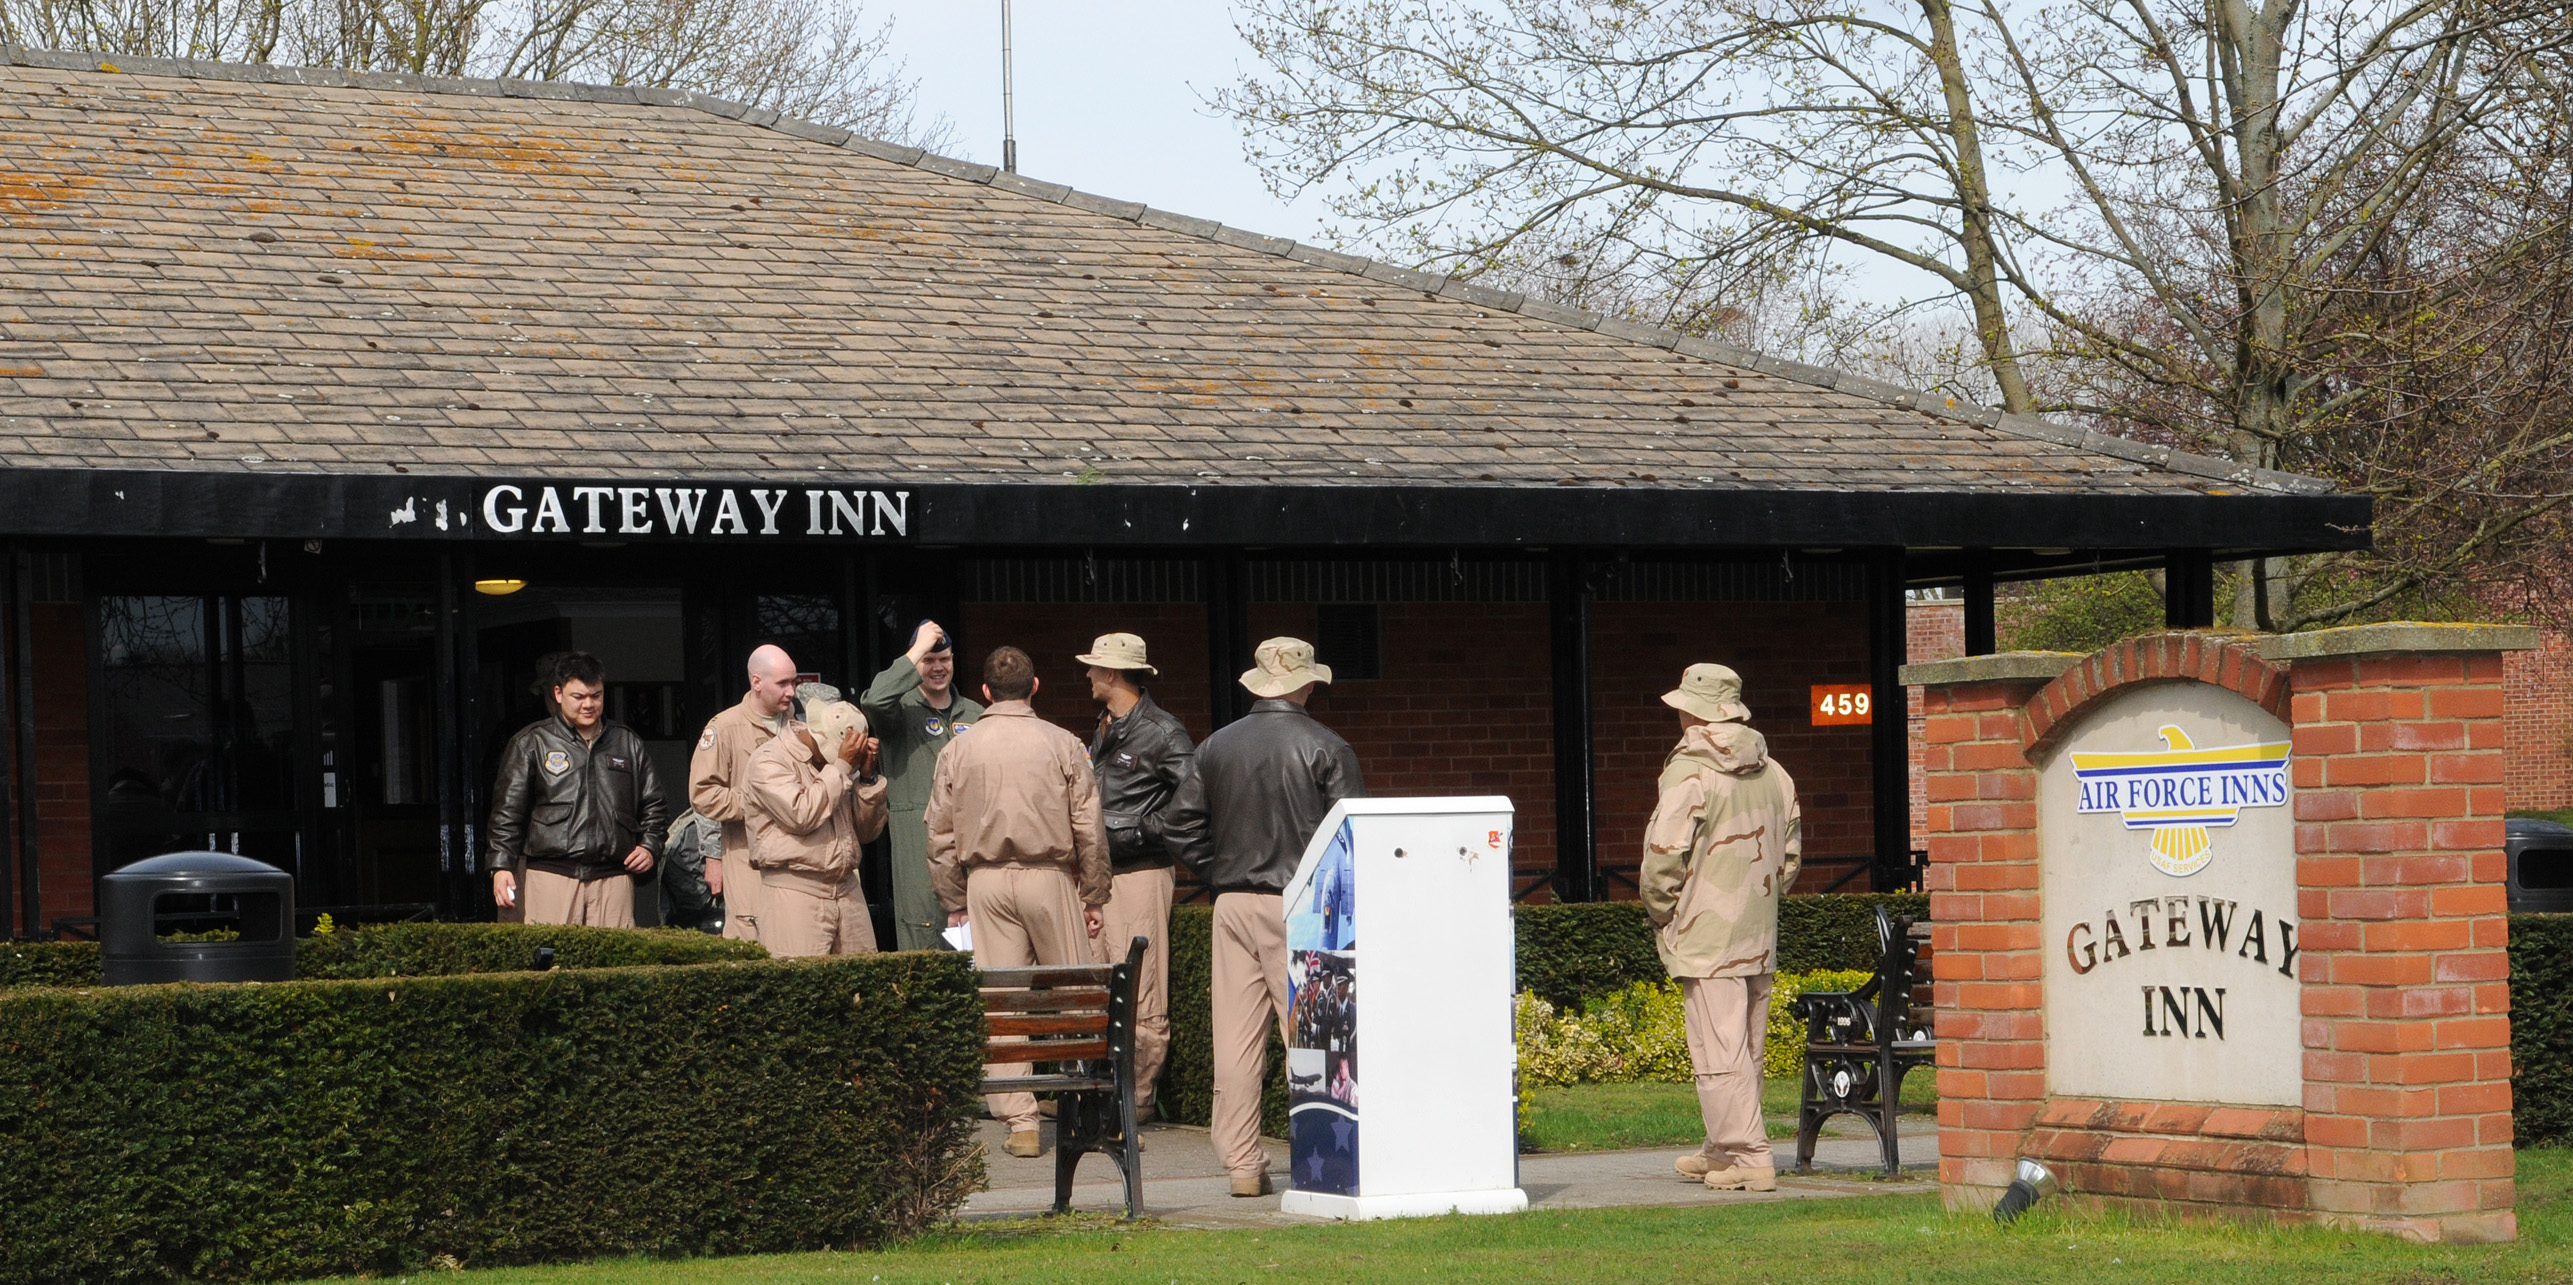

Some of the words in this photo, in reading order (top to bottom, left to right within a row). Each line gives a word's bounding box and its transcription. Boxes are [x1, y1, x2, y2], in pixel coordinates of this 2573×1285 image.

[483, 485, 788, 536] GATEWAY
[805, 489, 911, 537] INN
[1820, 693, 1870, 716] 459
[2078, 782, 2121, 810] AIR
[2128, 776, 2213, 808] FORCE
[2220, 772, 2286, 805] INNS
[2151, 851, 2172, 870] USAF
[2173, 850, 2211, 874] SERVICES
[2066, 894, 2299, 979] GATEWAY
[2141, 985, 2227, 1041] INN
